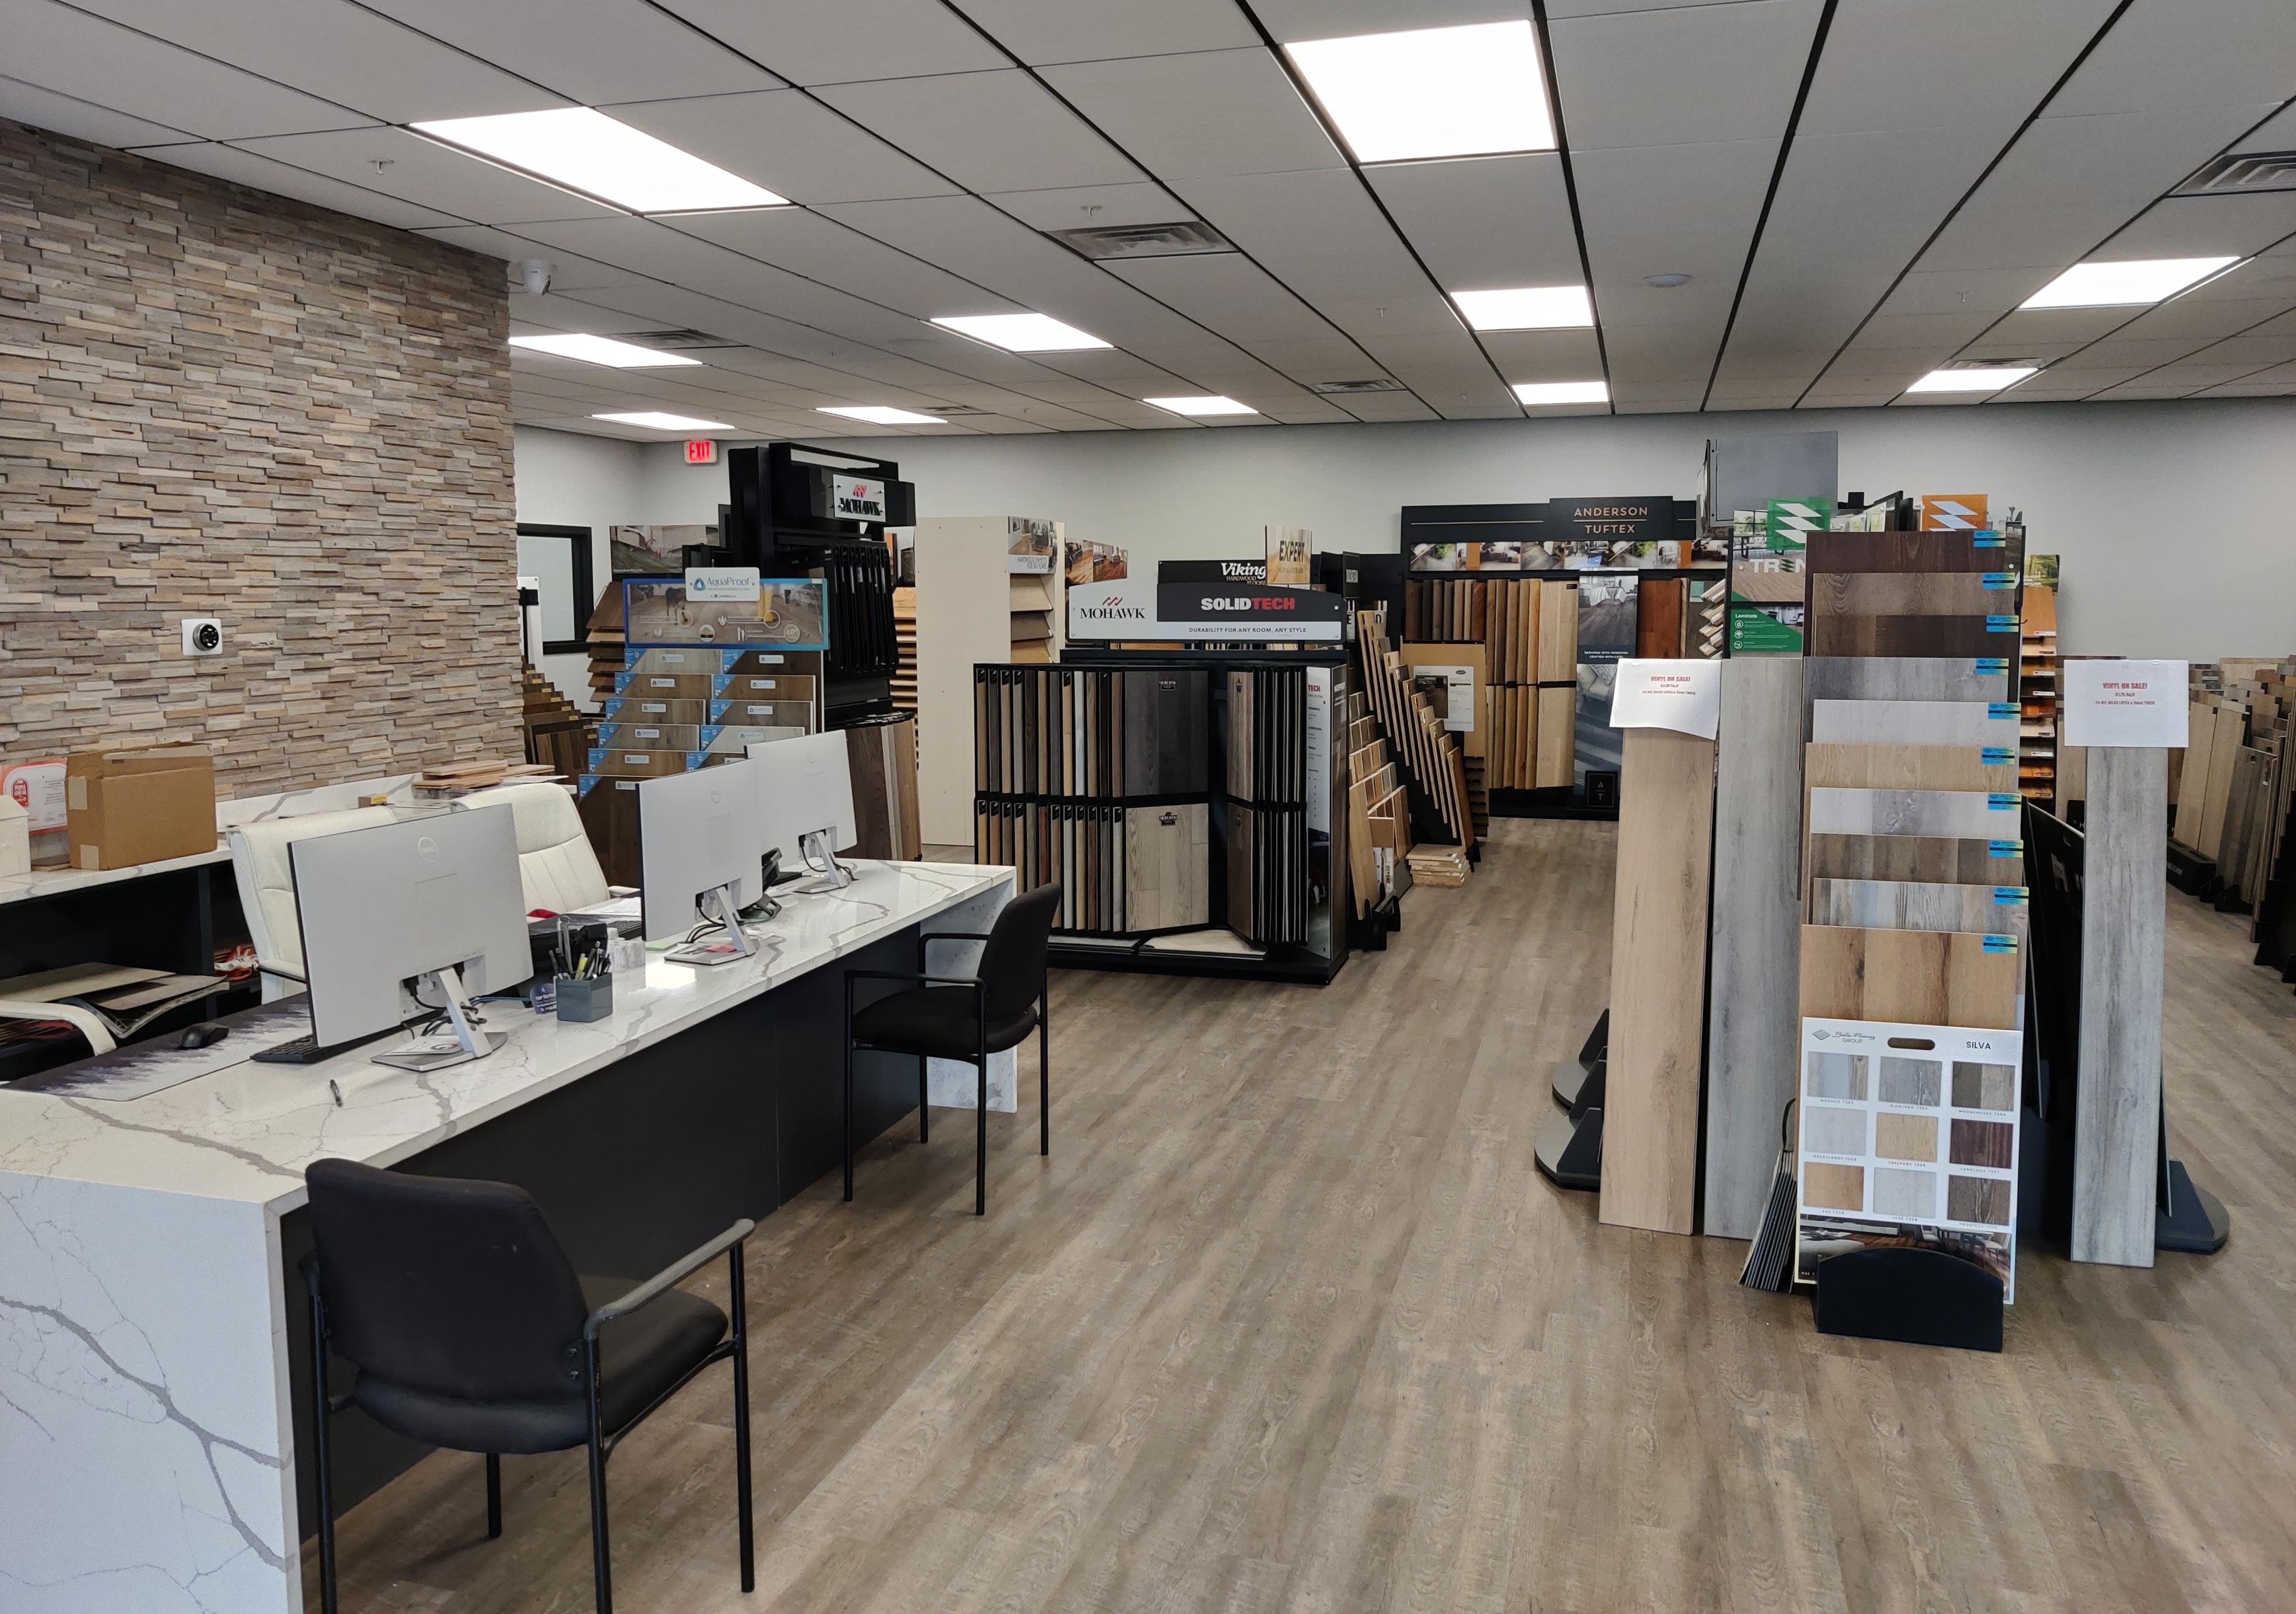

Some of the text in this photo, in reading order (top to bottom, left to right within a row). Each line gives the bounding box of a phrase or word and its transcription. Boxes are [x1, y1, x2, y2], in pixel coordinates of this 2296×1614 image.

[688, 441, 711, 462] EXIT
[839, 497, 882, 516] MOHAWK
[1573, 507, 1648, 517] ANDERSON
[1584, 524, 1635, 534] TUFTEX
[1279, 540, 1305, 563] EXPERT
[1220, 563, 1266, 579] Viking
[1201, 598, 1296, 610] SOLIDTECH
[1080, 608, 1145, 619] MOHAWK
[1966, 1041, 1991, 1050] SILVA
